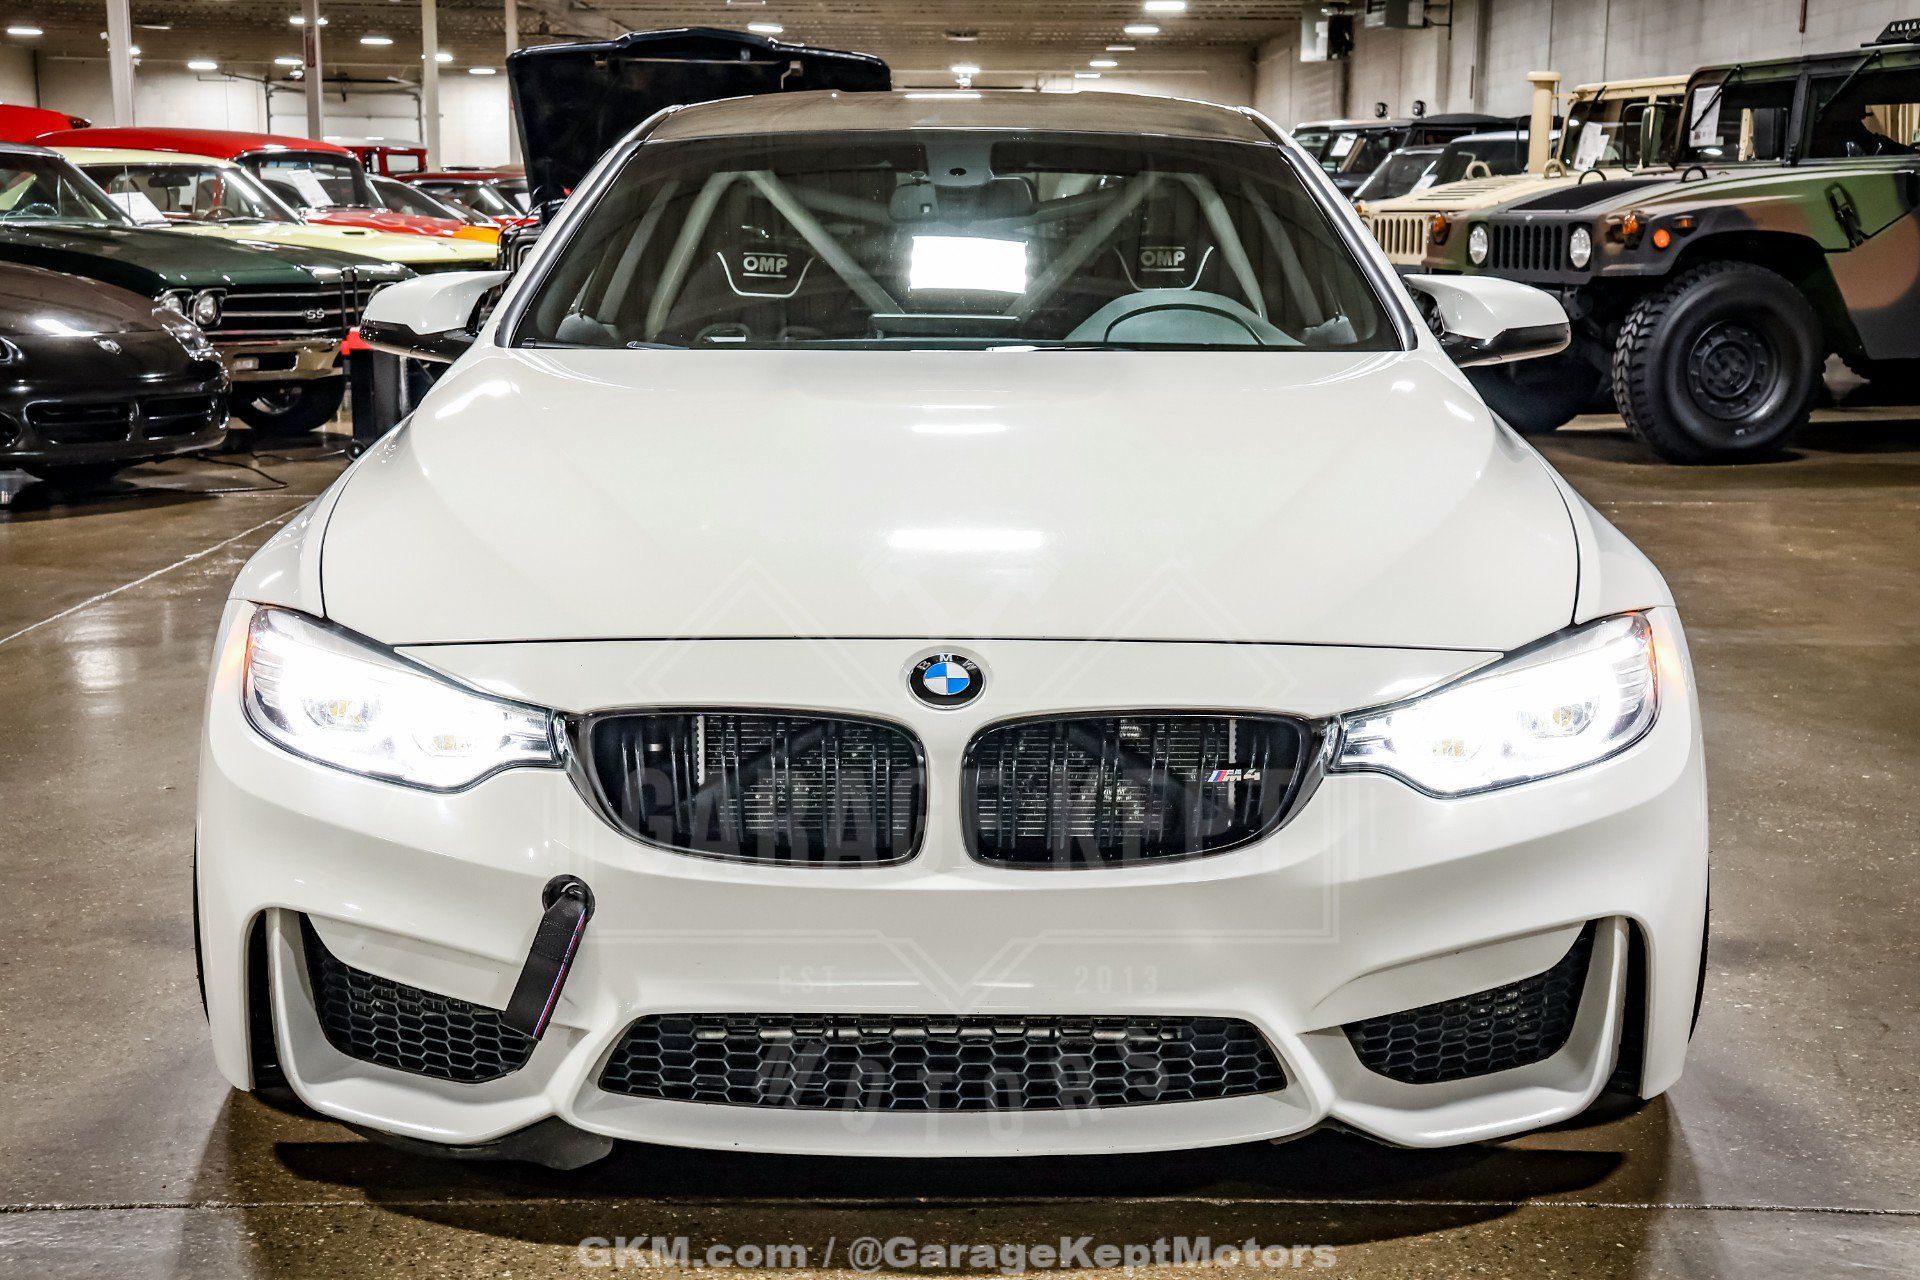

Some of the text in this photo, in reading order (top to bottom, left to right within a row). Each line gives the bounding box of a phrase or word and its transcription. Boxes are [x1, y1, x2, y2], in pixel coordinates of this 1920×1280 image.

[743, 256, 788, 273] OMP
[1140, 250, 1186, 267] OMP
[305, 308, 325, 320] SS
[917, 653, 977, 670] BMW
[1221, 769, 1260, 782] M4
